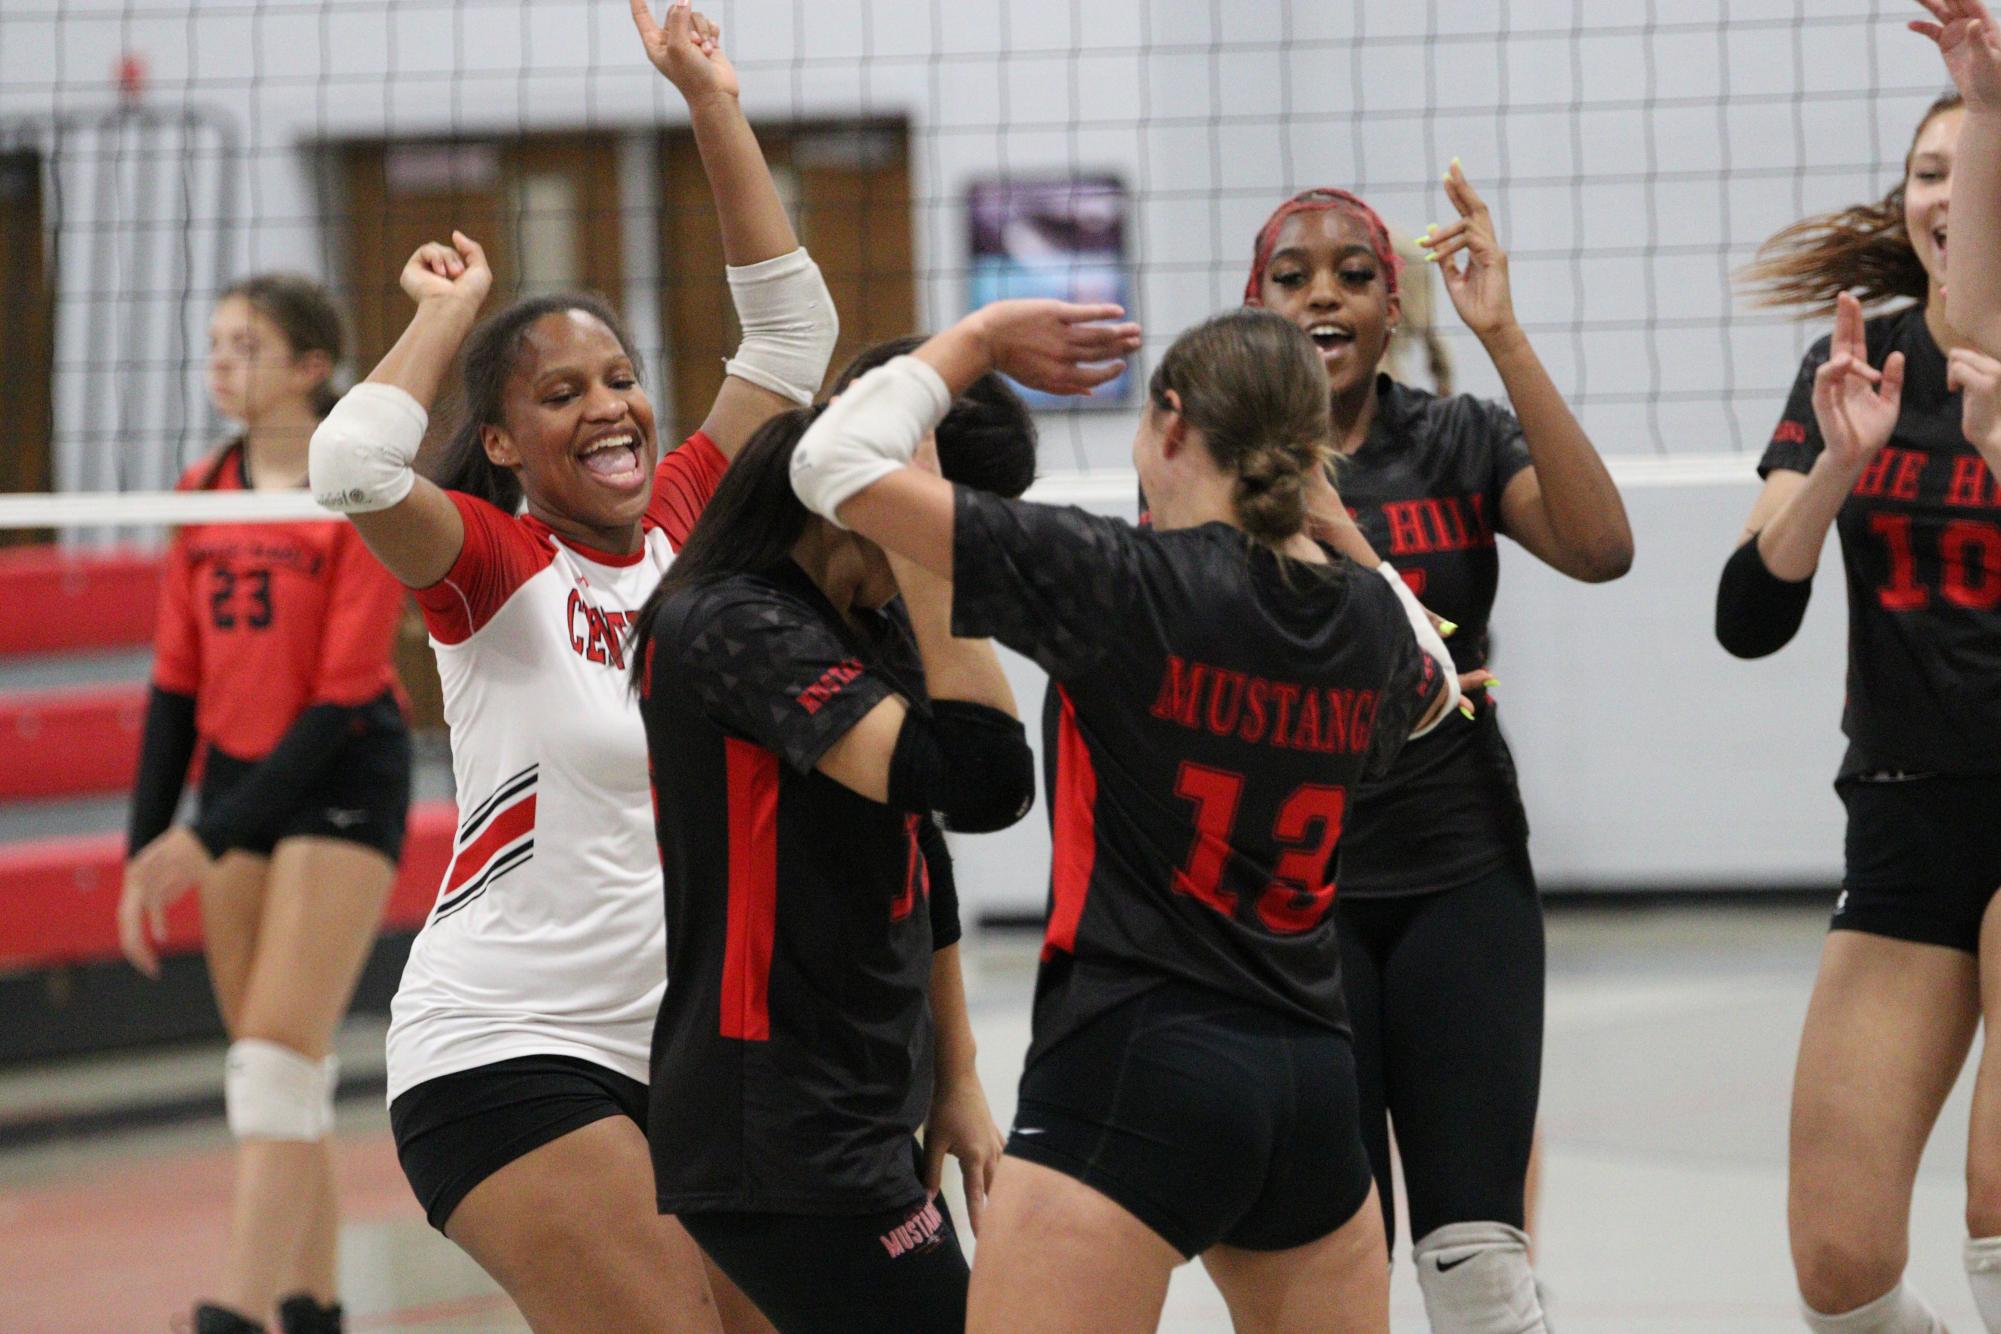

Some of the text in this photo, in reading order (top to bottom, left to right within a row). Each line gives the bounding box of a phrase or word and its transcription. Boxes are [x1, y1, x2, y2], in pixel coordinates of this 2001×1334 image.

[1852, 447, 1929, 499] HE
[212, 569, 273, 629] 23
[1869, 512, 2001, 614] 10
[566, 587, 641, 671] CENT
[1151, 654, 1381, 757] MUSTANG
[1170, 760, 1346, 936] 13
[880, 1201, 943, 1259] MUSTAN
